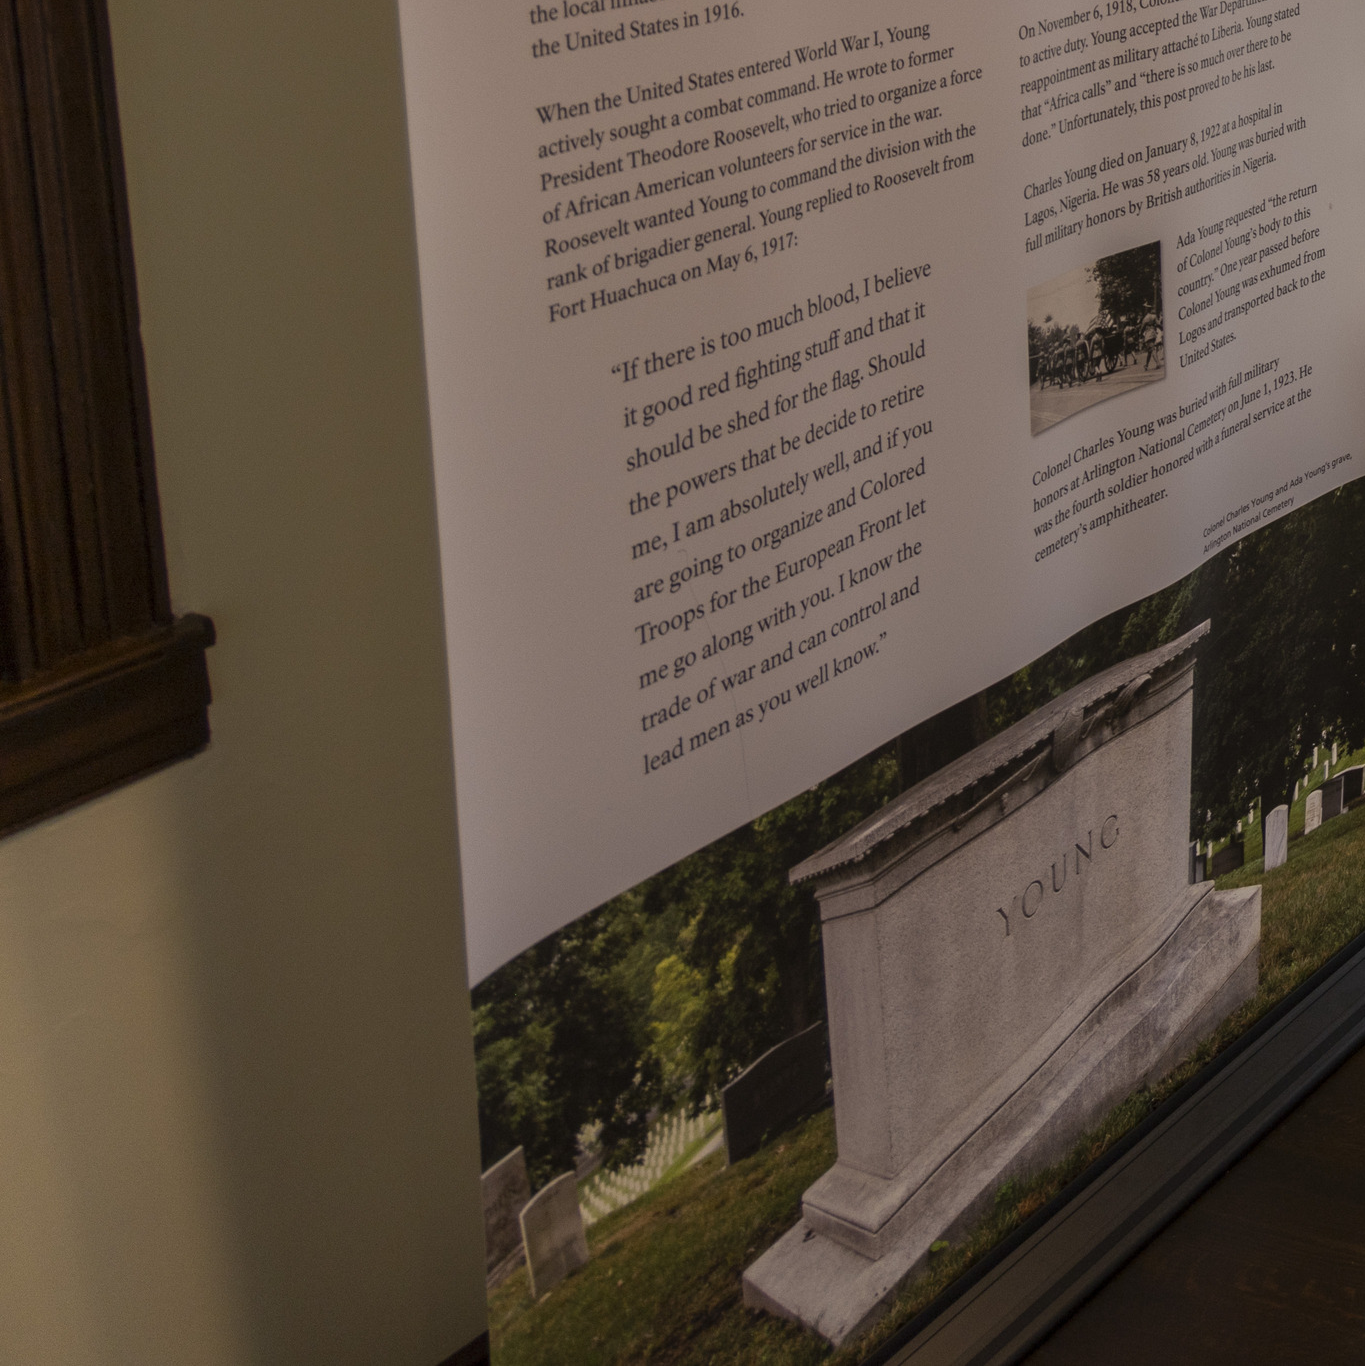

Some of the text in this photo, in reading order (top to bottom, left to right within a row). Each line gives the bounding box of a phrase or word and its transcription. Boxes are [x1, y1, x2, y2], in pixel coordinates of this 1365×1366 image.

[611, 263, 931, 383] “If there is too much blood, I believe
[1203, 516, 1225, 538] Colonel
[1226, 504, 1250, 522] Charles
[1250, 492, 1274, 508] Young
[1275, 483, 1288, 496] and
[1289, 476, 1303, 488] Ada
[1331, 452, 1353, 469] grave,
[1203, 496, 1295, 554] Arlington National Cemetery
[996, 814, 1120, 936] YOUNG
